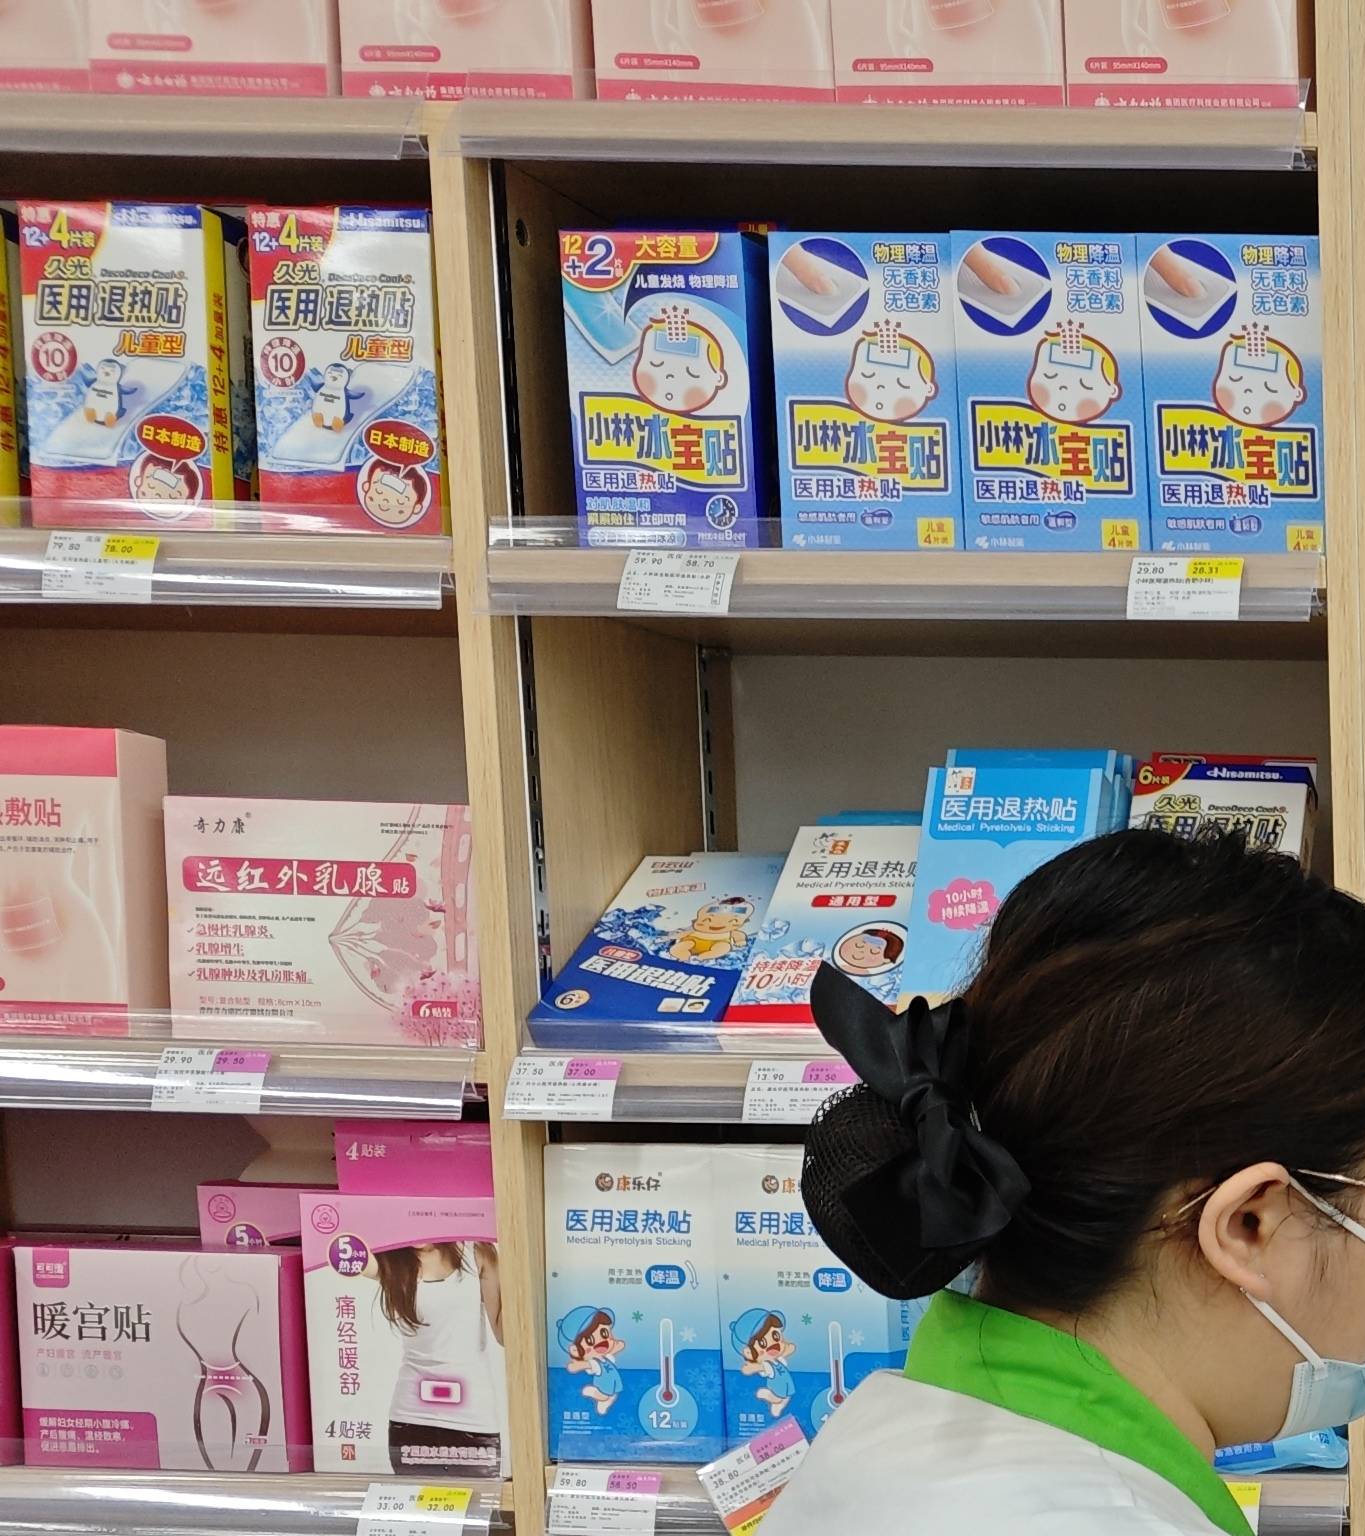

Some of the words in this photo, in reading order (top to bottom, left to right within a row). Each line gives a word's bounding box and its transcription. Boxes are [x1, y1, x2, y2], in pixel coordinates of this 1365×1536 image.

[634, 237, 700, 257] 大容量
[872, 243, 938, 266] 物理降温
[1057, 241, 1123, 265] 物理降温
[1241, 244, 1307, 268] 物理降温
[45, 257, 90, 277] 久光
[883, 268, 940, 289] 无香料
[884, 291, 940, 312] 无色素
[115, 332, 186, 357] 儿童型
[342, 336, 413, 361] 儿童型
[43, 347, 65, 368] 10
[141, 424, 203, 453] 日本制造
[369, 429, 430, 458] 日本制造
[585, 410, 737, 478] 小林冰宝贴
[1163, 421, 1312, 485] 小林冰宝贴
[584, 471, 676, 494] 医用退热贴
[1161, 481, 1270, 506] 医用退热贴
[940, 796, 1078, 821] 医用退热贴
[194, 817, 245, 834] 奇力康
[938, 822, 977, 833] Medical
[979, 822, 1034, 834] Pyretolysis
[1036, 822, 1076, 834] Sticking
[195, 860, 410, 896] 远红外乳腺贴
[826, 894, 881, 908] 通用型
[942, 903, 992, 920] 持续降温
[616, 1174, 661, 1192] 康乐仔
[566, 1209, 692, 1234] 医用退热贴
[566, 1236, 601, 1245] Medical
[604, 1236, 652, 1248] Pyretolysis
[655, 1236, 692, 1248] Sticking
[650, 1269, 681, 1286] 降温
[32, 1302, 152, 1343] 暖宫贴
[335, 1295, 361, 1396] 痛经暖舒
[325, 1420, 373, 1438] 4贴装
